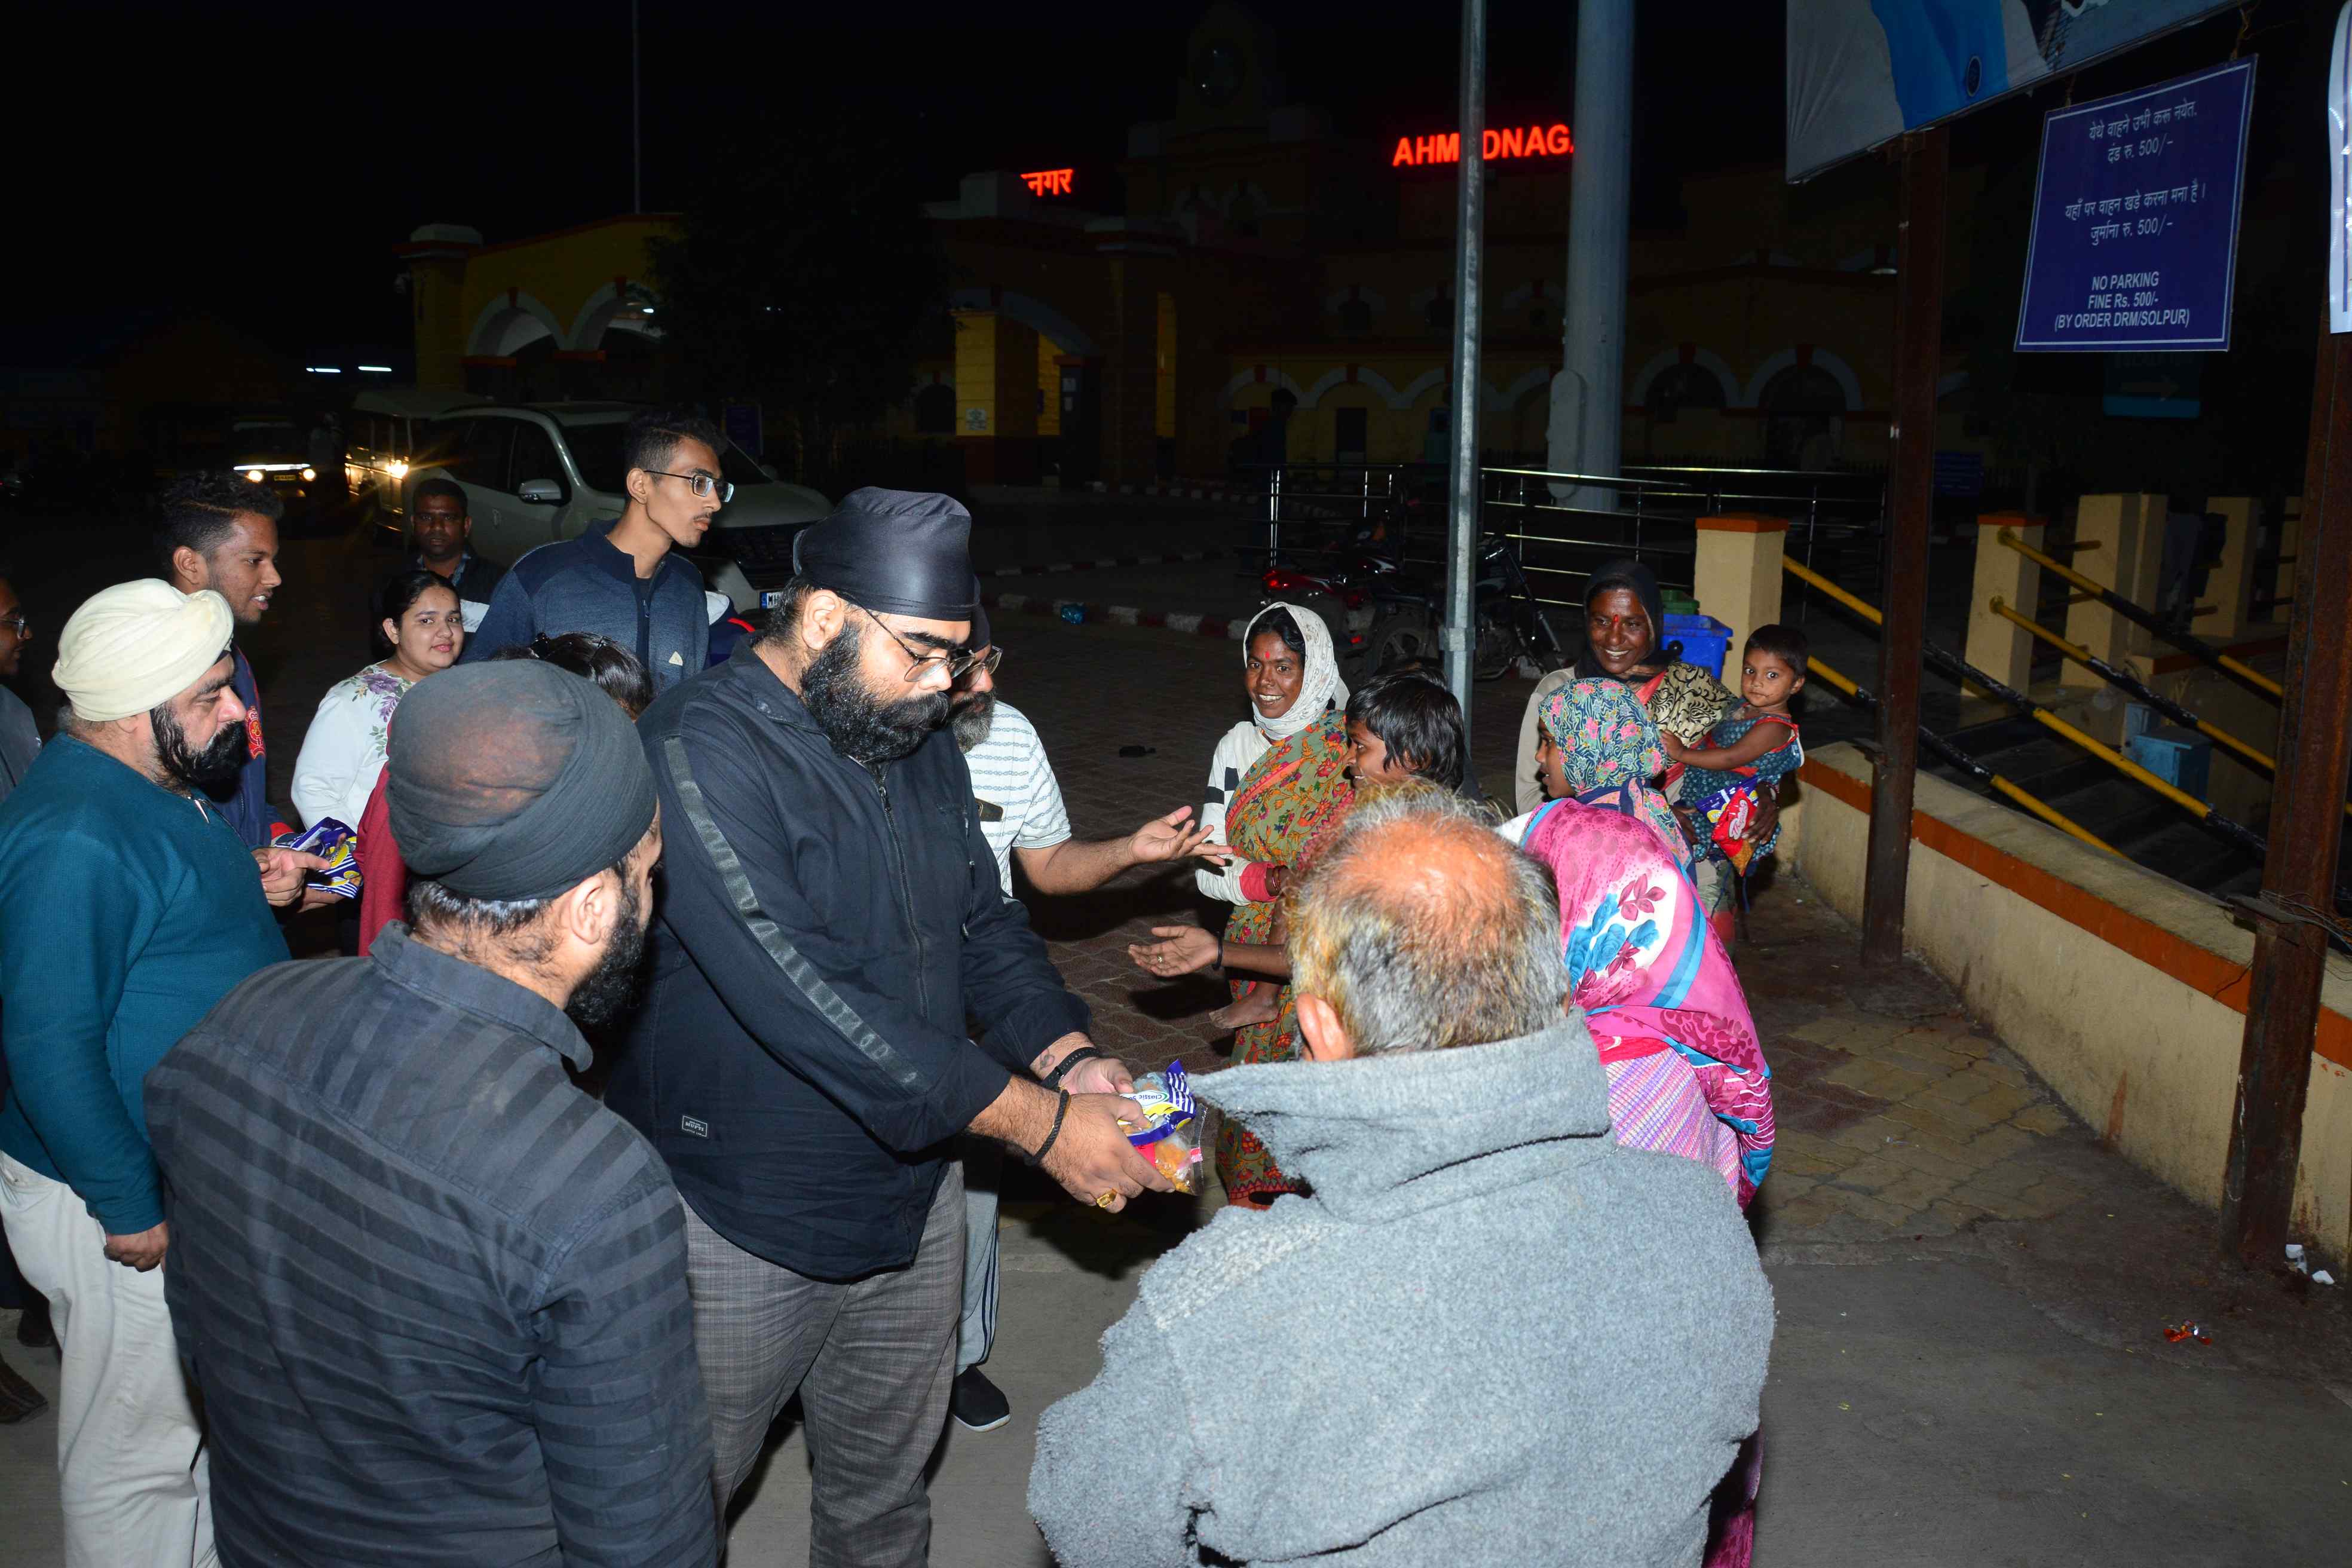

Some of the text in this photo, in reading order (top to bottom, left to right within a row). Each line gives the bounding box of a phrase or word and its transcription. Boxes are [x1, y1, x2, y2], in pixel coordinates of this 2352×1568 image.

[2089, 120, 2105, 141] येथे
[2108, 114, 2130, 138] वाहने
[2133, 108, 2151, 131] उभी
[2108, 143, 2121, 163] दंड
[2139, 133, 2173, 157] 500/-
[1019, 169, 1074, 197] नगर
[2065, 198, 2083, 220] यहाँ
[2084, 202, 2096, 217] पर
[2099, 198, 2121, 216] वाहन
[2124, 189, 2141, 213] खड़े
[2143, 190, 2168, 209] करना
[2171, 186, 2188, 203] मना
[2091, 219, 2120, 246] जुर्माना
[2137, 214, 2173, 236] 500/-
[2091, 271, 2159, 291] NO PARKING
[2088, 291, 2158, 309] FINE Rs. 500/-
[2054, 308, 2189, 332] (BY ORDER DRM/SOLPUR)
